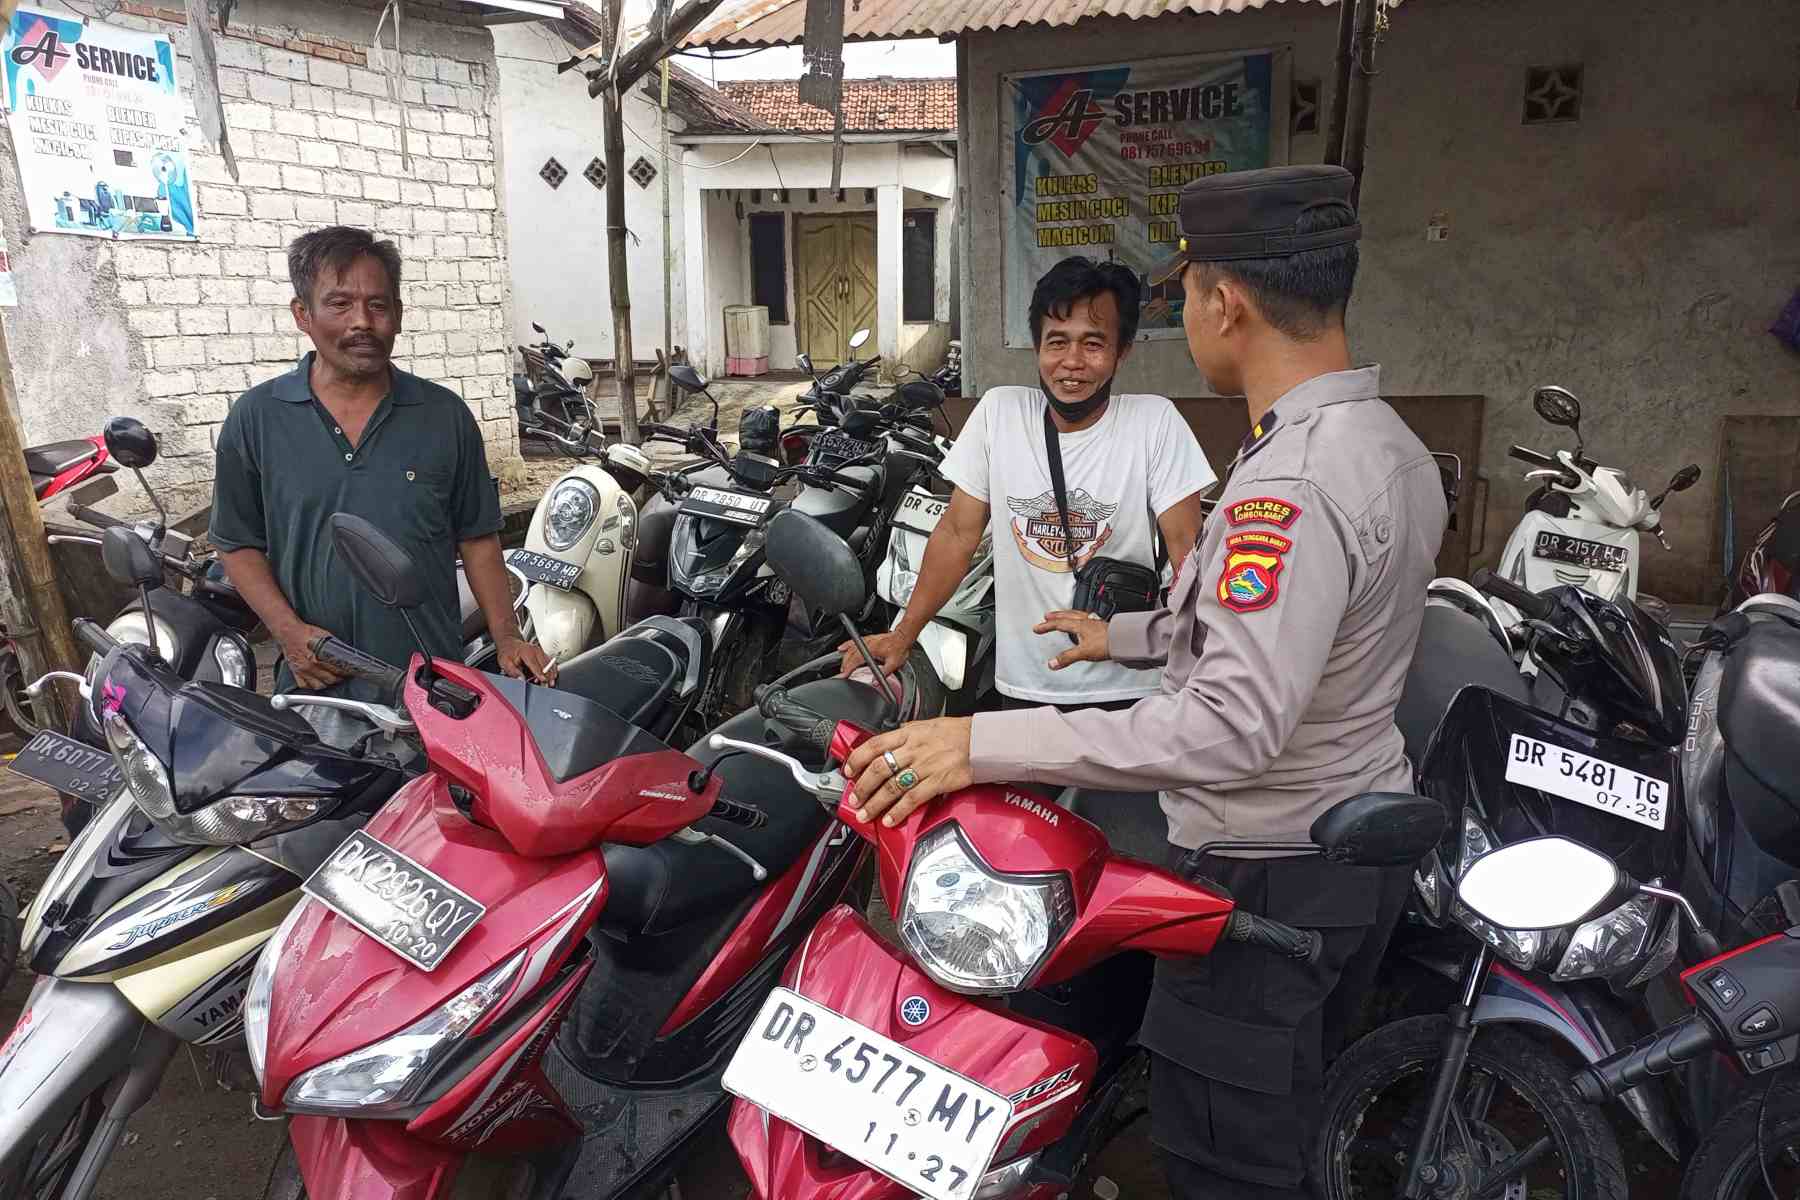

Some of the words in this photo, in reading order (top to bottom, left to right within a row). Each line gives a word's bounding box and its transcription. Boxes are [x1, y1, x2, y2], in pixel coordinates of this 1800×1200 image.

[75, 42, 159, 83] SERVICE
[106, 105, 157, 129] BLENDER
[1114, 82, 1243, 128] SERVICE
[1151, 126, 1173, 142] CALL
[1035, 174, 1097, 196] KULKAS
[1036, 201, 1087, 223] MESIN
[1088, 198, 1130, 219] CUCI
[1148, 191, 1181, 216] KIP
[1037, 223, 1115, 248] MAGICOM
[695, 488, 708, 499] DR
[751, 500, 768, 512] UT
[904, 496, 922, 511] DR
[1234, 501, 1291, 517] POLRES
[1539, 533, 1560, 549] DR
[1565, 539, 1601, 557] 2157
[514, 550, 531, 562] DR
[560, 564, 578, 577] MB
[1685, 688, 1711, 752] VARIO
[29, 734, 62, 757] DK
[54, 745, 107, 773] 6077
[1514, 738, 1546, 767] DR
[1559, 752, 1616, 791] 5481
[1633, 775, 1661, 805] TG
[1005, 792, 1059, 827] YAMAHA
[331, 839, 381, 882] DK
[363, 860, 437, 919] 2926
[424, 898, 475, 938] QY
[762, 1001, 817, 1055] DR
[823, 1035, 927, 1107] 4577
[928, 1083, 996, 1143] MY
